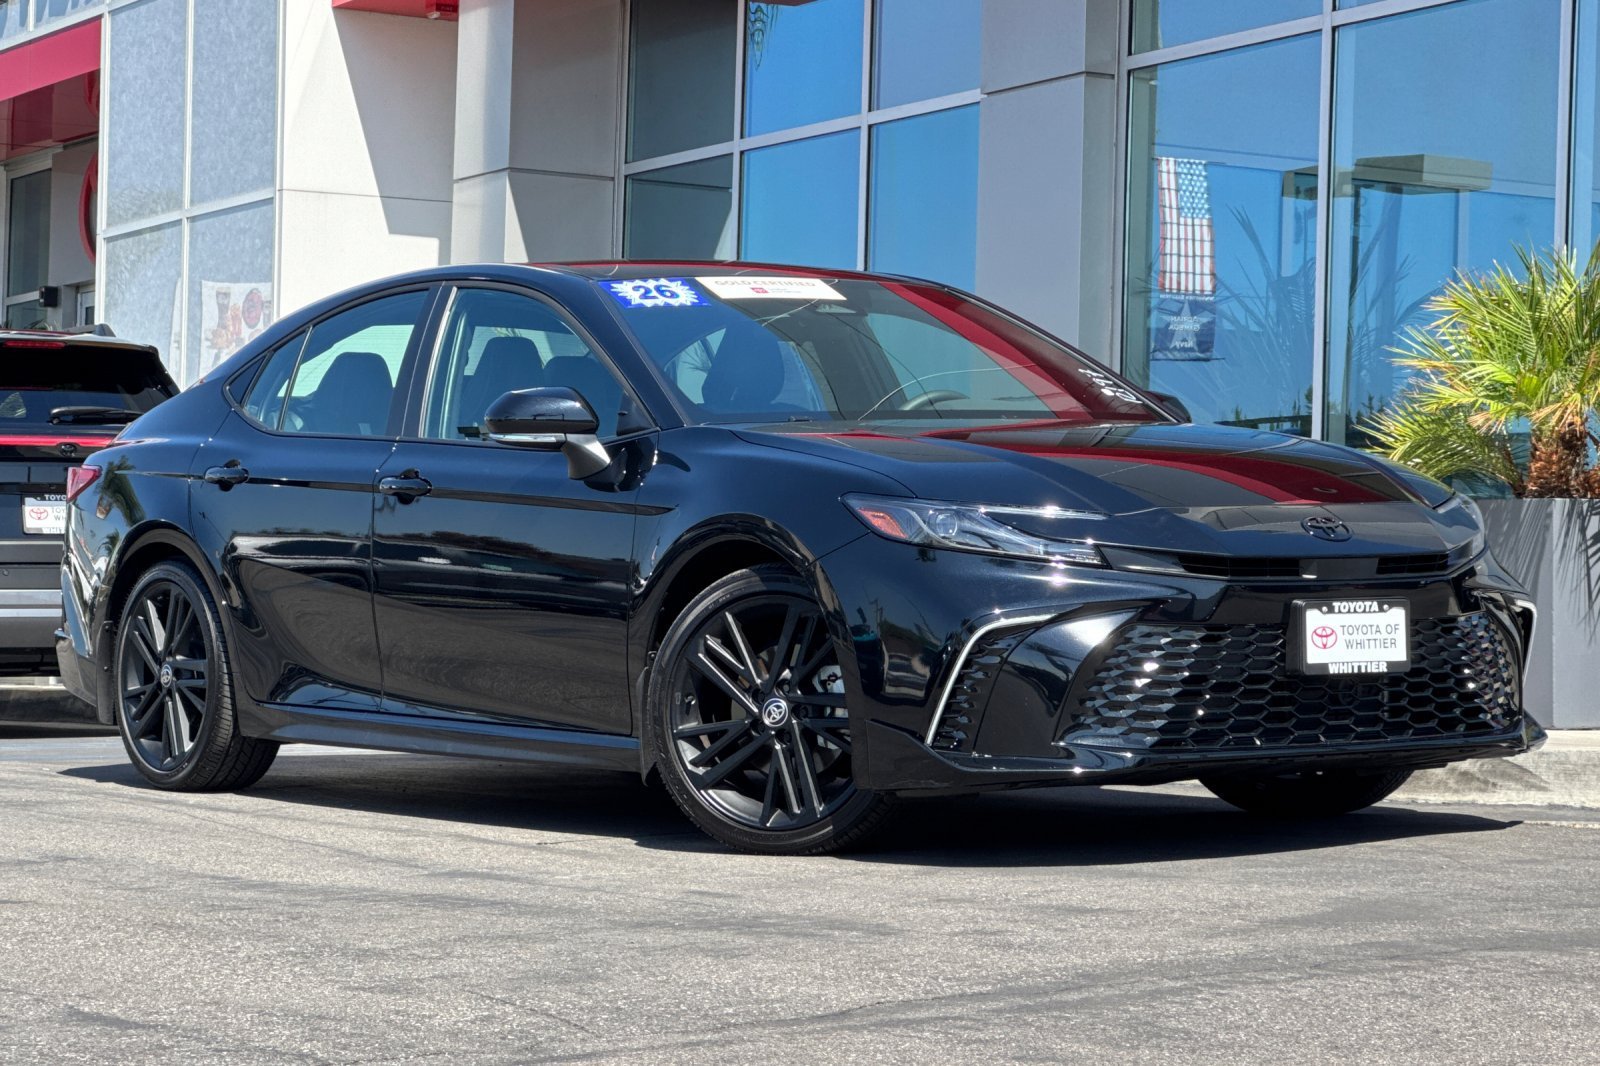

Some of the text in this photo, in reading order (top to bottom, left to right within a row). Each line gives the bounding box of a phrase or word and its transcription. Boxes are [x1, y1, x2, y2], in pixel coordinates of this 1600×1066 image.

[632, 283, 681, 300] 26
[1332, 601, 1379, 613] TOYOTA
[1340, 623, 1400, 636] TOYOTA OF
[1344, 638, 1397, 650] WHITTIER
[1328, 661, 1388, 674] WHITTIER
